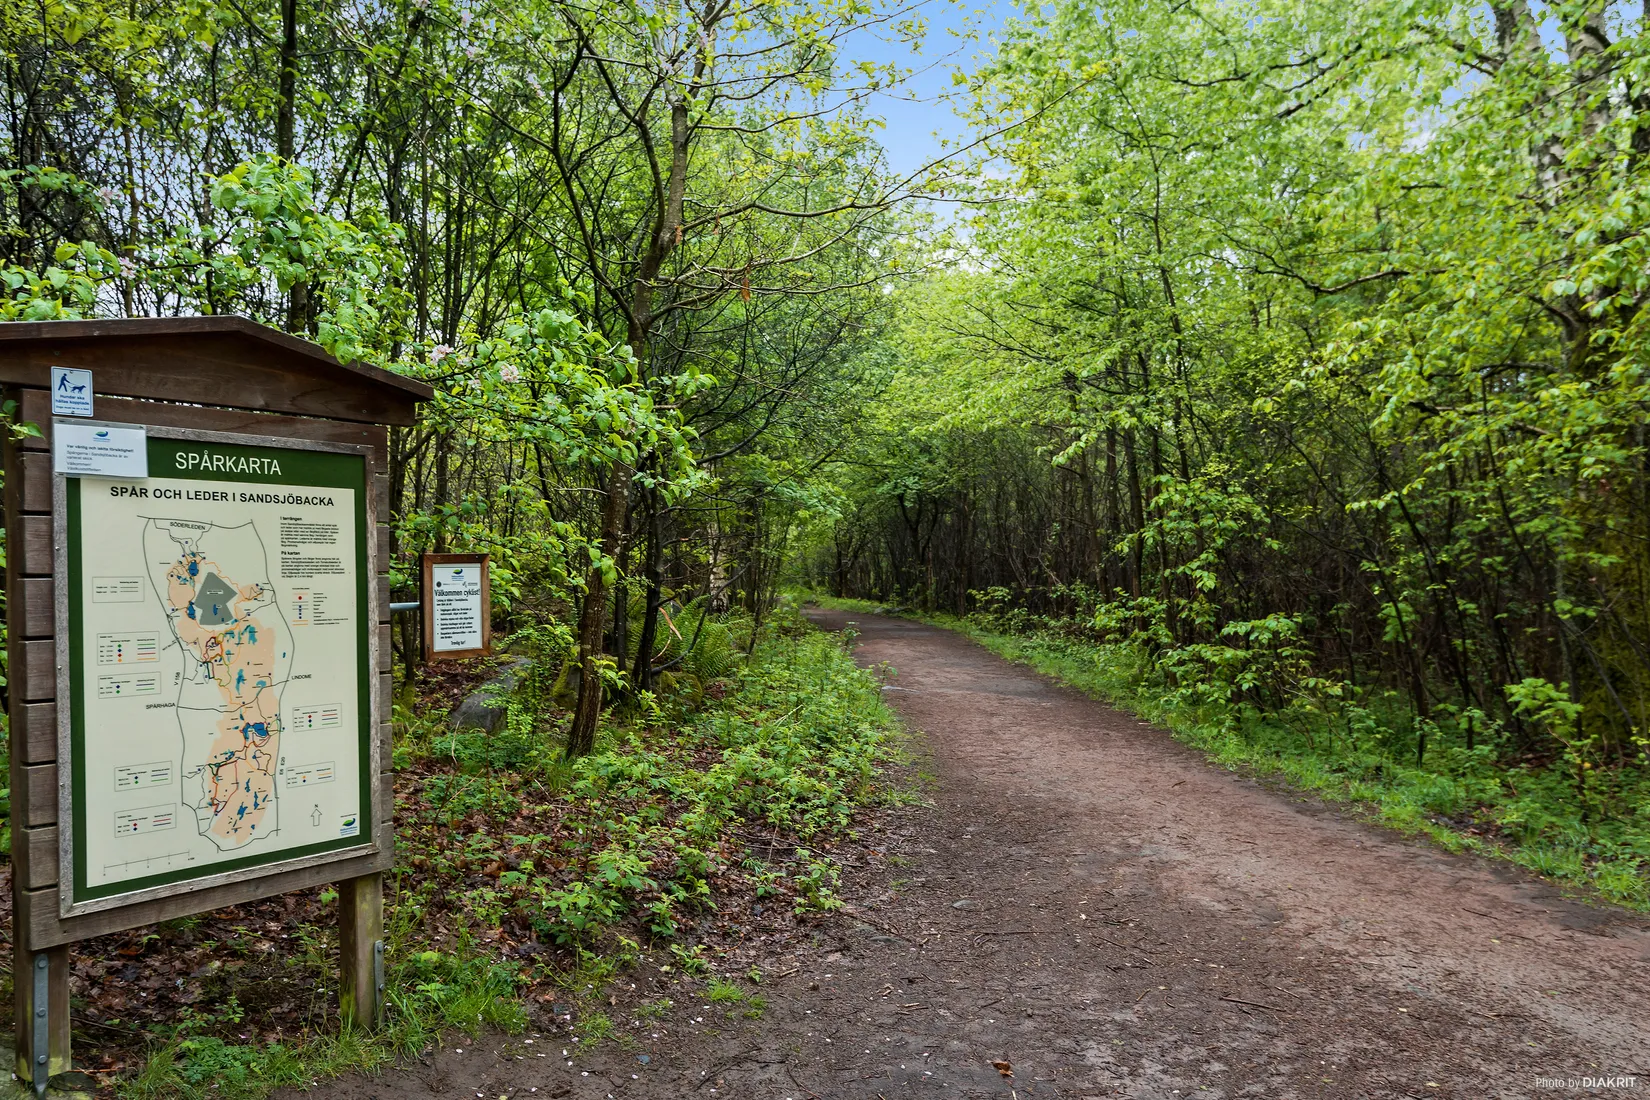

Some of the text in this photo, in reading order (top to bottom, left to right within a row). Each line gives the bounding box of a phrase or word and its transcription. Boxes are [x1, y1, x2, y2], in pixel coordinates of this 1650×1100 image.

[175, 450, 282, 475] SPÅRKARTA
[110, 486, 335, 507] SPÅR OCH LEDER I SANDSJÖBACKA
[169, 521, 206, 530] SÖDERLEDEN
